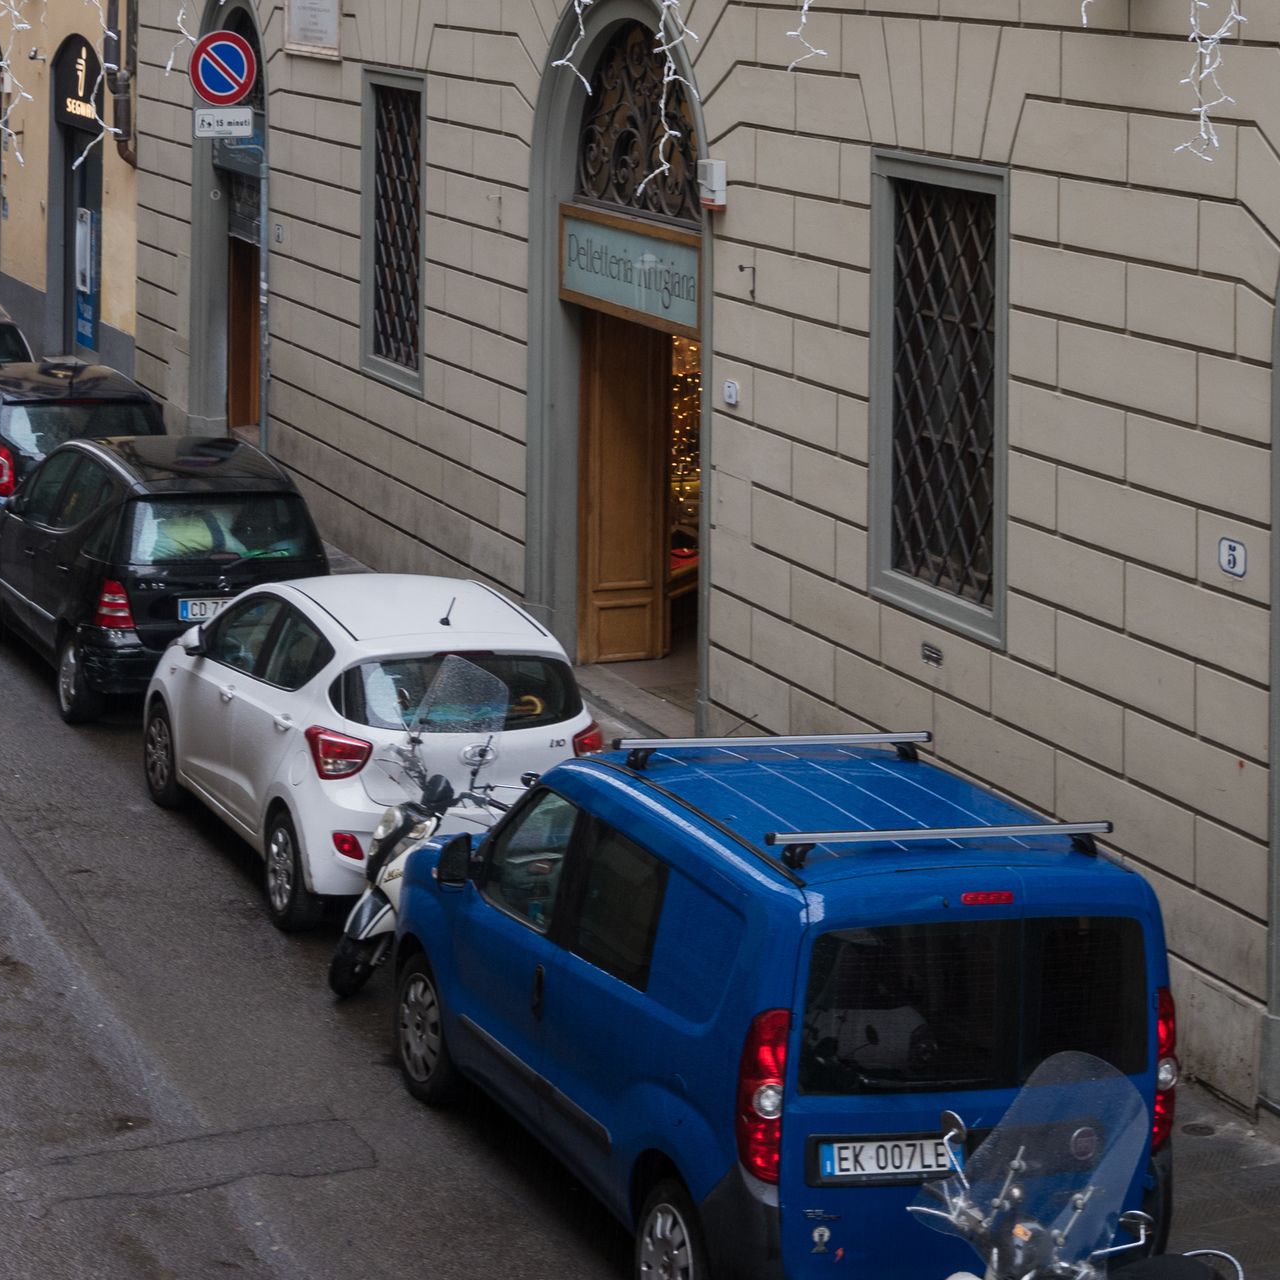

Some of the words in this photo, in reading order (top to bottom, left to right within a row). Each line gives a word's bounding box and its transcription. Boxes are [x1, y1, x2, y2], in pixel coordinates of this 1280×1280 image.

[227, 119, 250, 127] minuti
[567, 233, 634, 284] Pelletteria
[637, 256, 696, 309] Artigiana
[190, 602, 207, 617] CD
[837, 1145, 865, 1172] EK
[875, 1141, 948, 1170] 007LE
